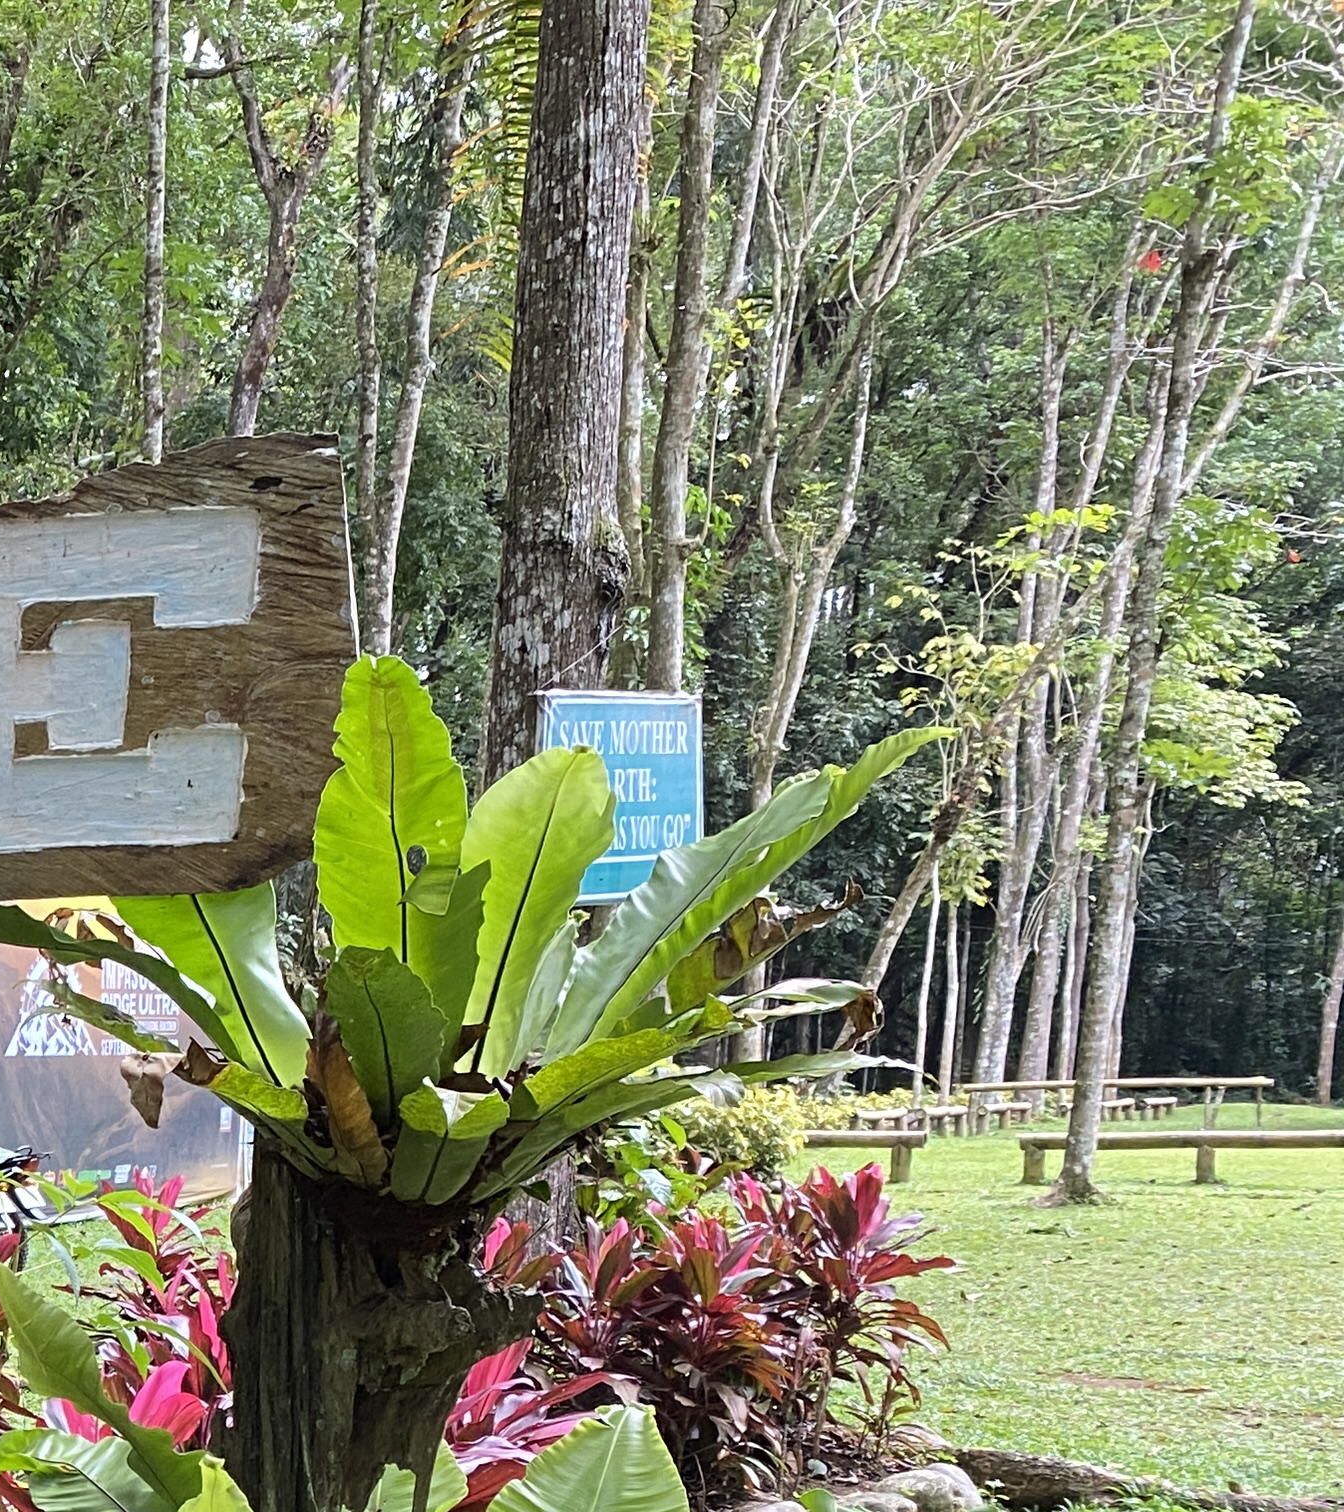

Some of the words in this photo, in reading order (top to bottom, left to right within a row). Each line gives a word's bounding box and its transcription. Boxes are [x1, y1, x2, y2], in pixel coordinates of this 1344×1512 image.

[559, 720, 605, 755] SAVE
[608, 720, 689, 755] MOTHER
[629, 815, 661, 850] YOU
[138, 993, 180, 1015] ULTRA
